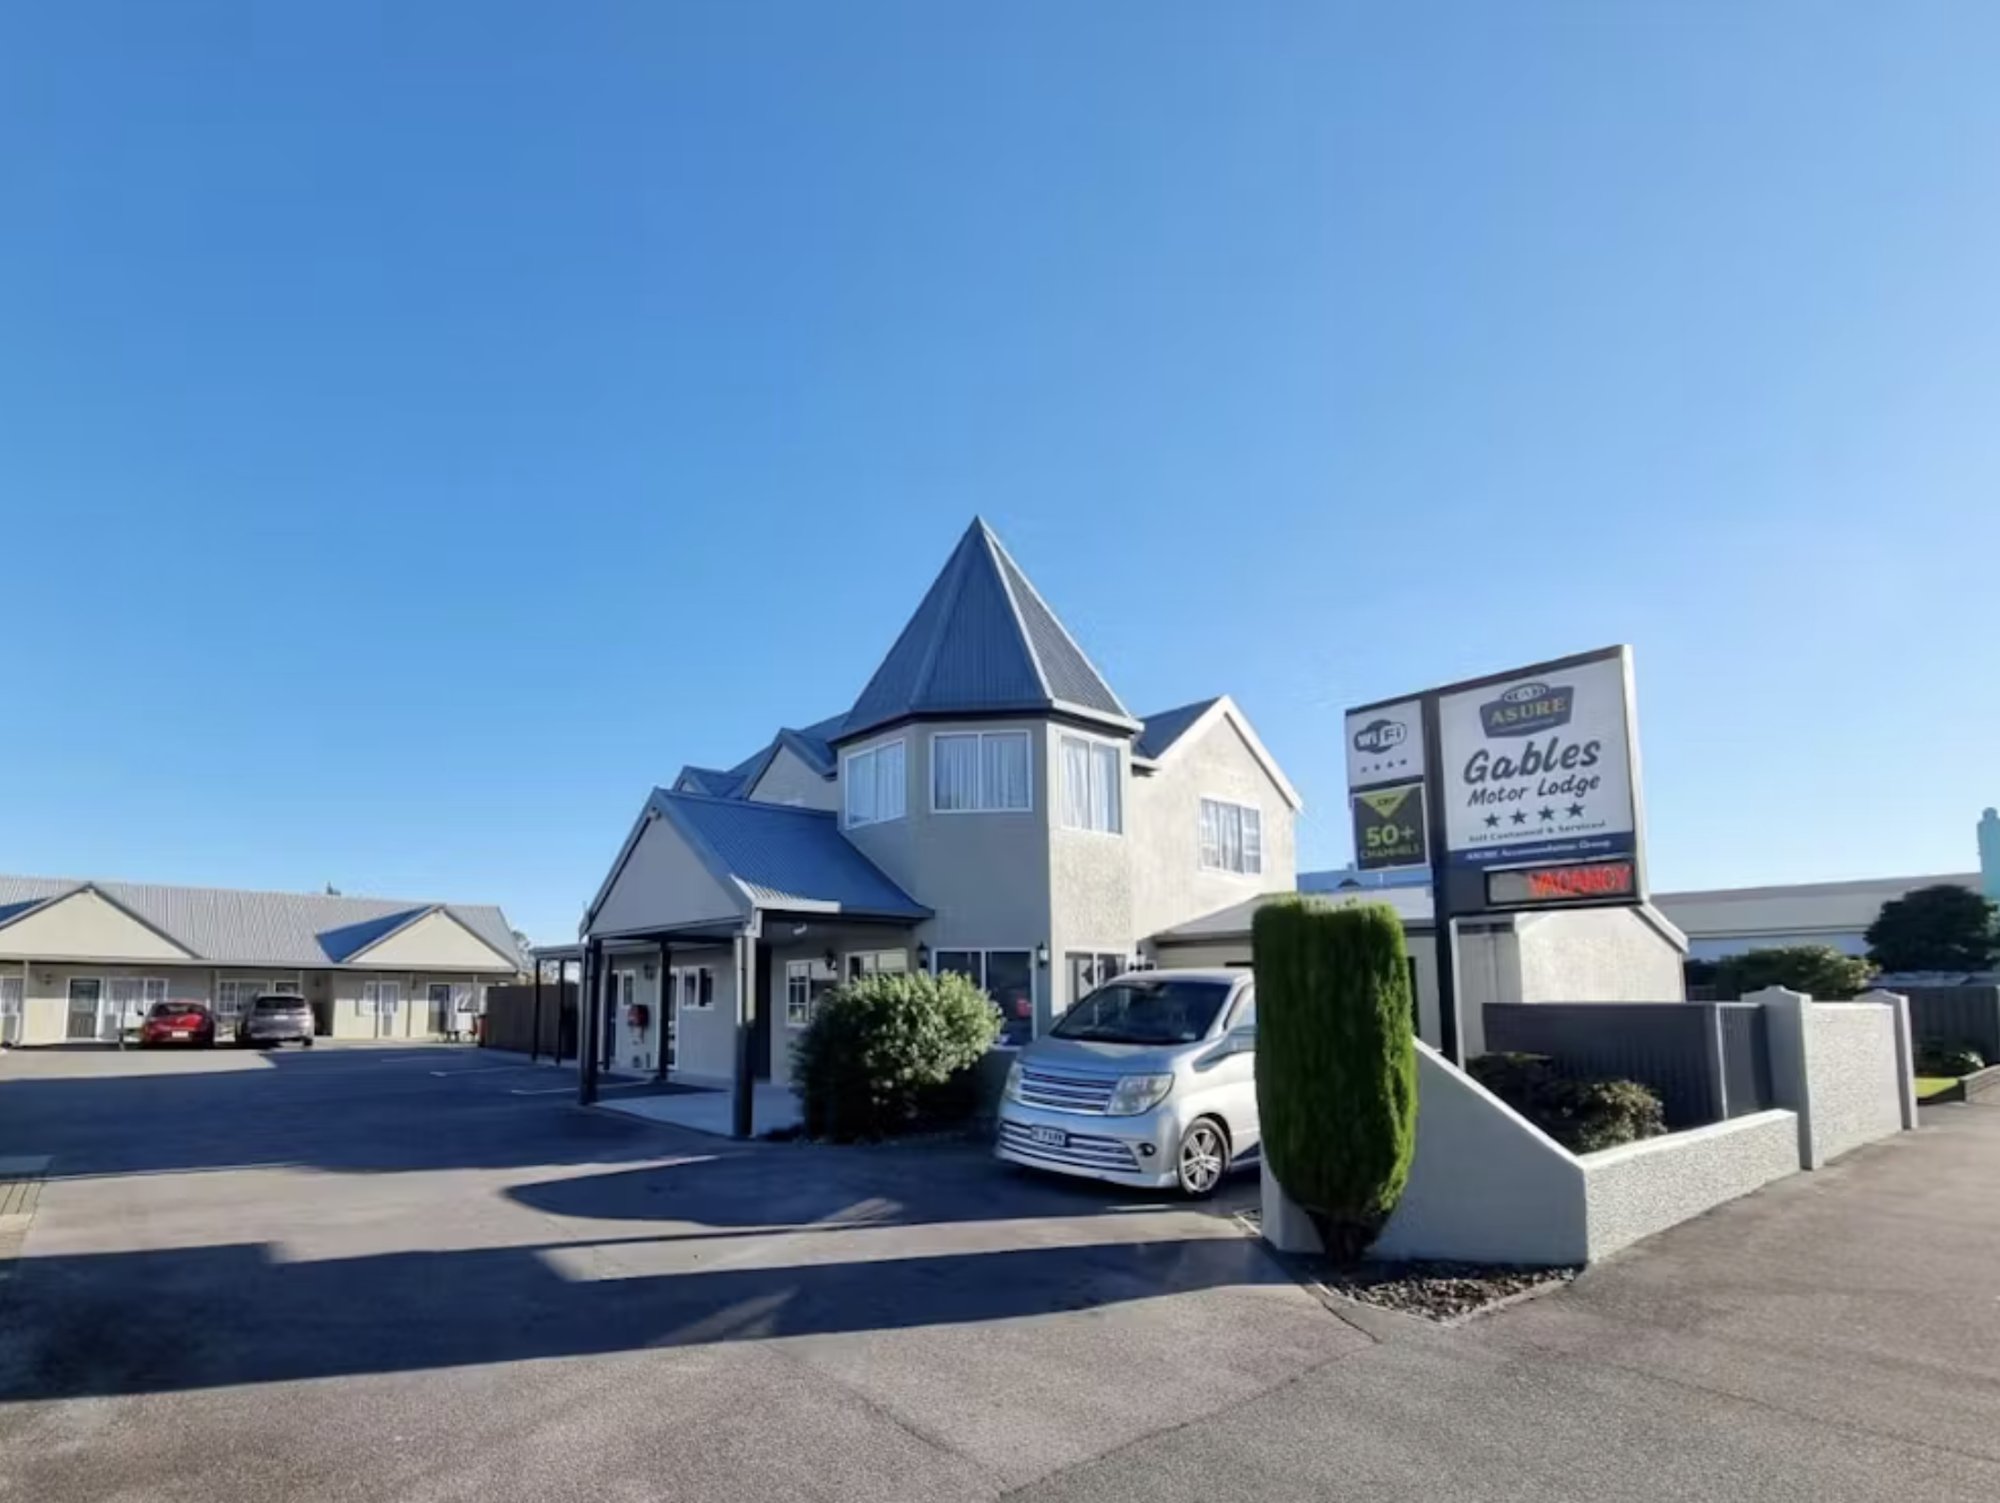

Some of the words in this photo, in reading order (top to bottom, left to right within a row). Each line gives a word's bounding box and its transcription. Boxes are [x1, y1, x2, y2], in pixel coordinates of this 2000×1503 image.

[1491, 697, 1567, 727] ASURE
[1463, 736, 1601, 785] Gables
[1467, 786, 1529, 807] Motor
[1537, 774, 1601, 798] Lodge
[1366, 824, 1416, 848] 50+
